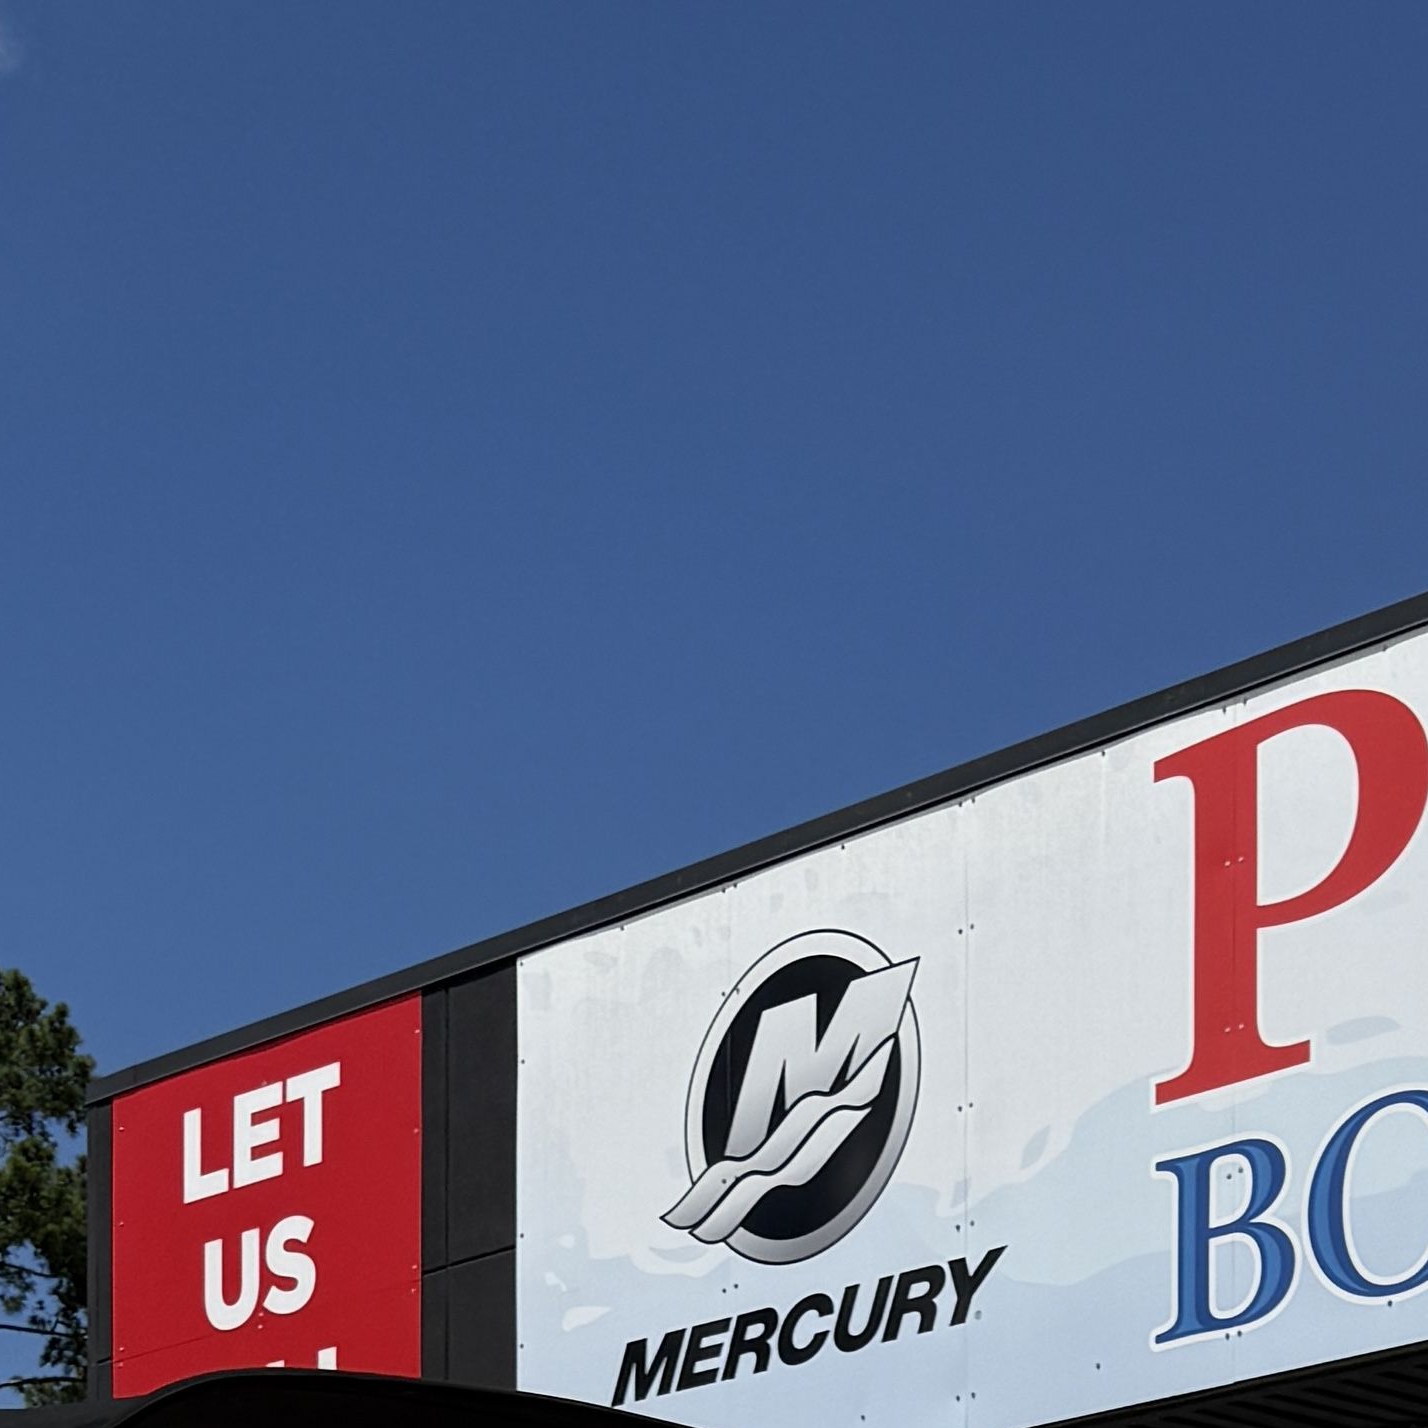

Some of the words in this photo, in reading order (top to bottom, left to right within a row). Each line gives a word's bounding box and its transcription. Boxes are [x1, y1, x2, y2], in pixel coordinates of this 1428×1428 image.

[182, 1062, 341, 1204] LET
[202, 1215, 318, 1332] US
[611, 1245, 1008, 1408] MERCURY
